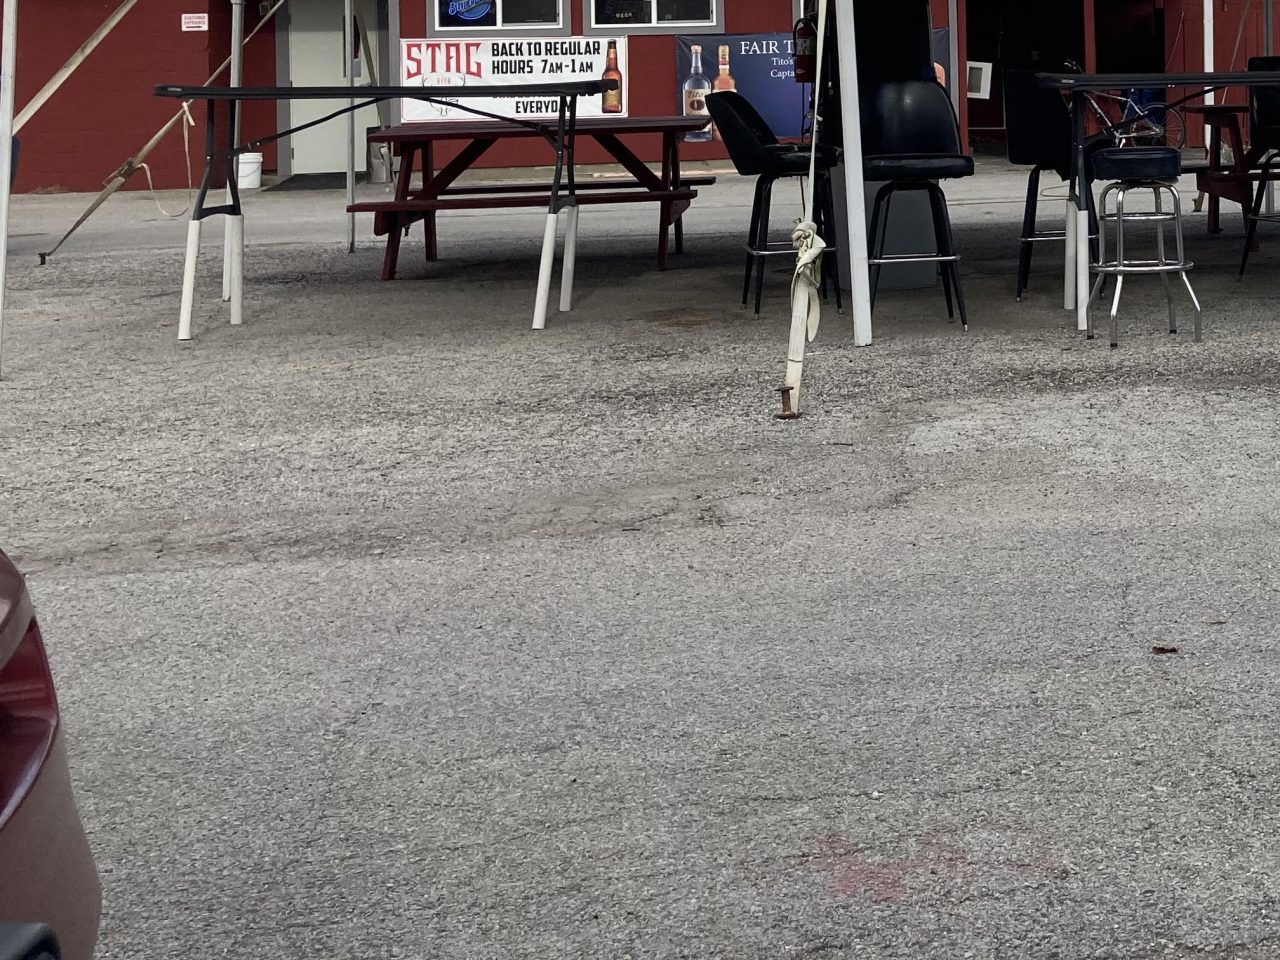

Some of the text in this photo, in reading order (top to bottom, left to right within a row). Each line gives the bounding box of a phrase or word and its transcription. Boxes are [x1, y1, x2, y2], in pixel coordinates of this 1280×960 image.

[492, 40, 601, 57] BACK TO REGULAR
[740, 40, 781, 55] FAIR
[406, 42, 483, 79] STAG
[492, 59, 534, 75] HOURS
[771, 57, 794, 66] Tito's
[770, 69, 795, 79] Capta
[515, 100, 572, 113] EVERYDY
